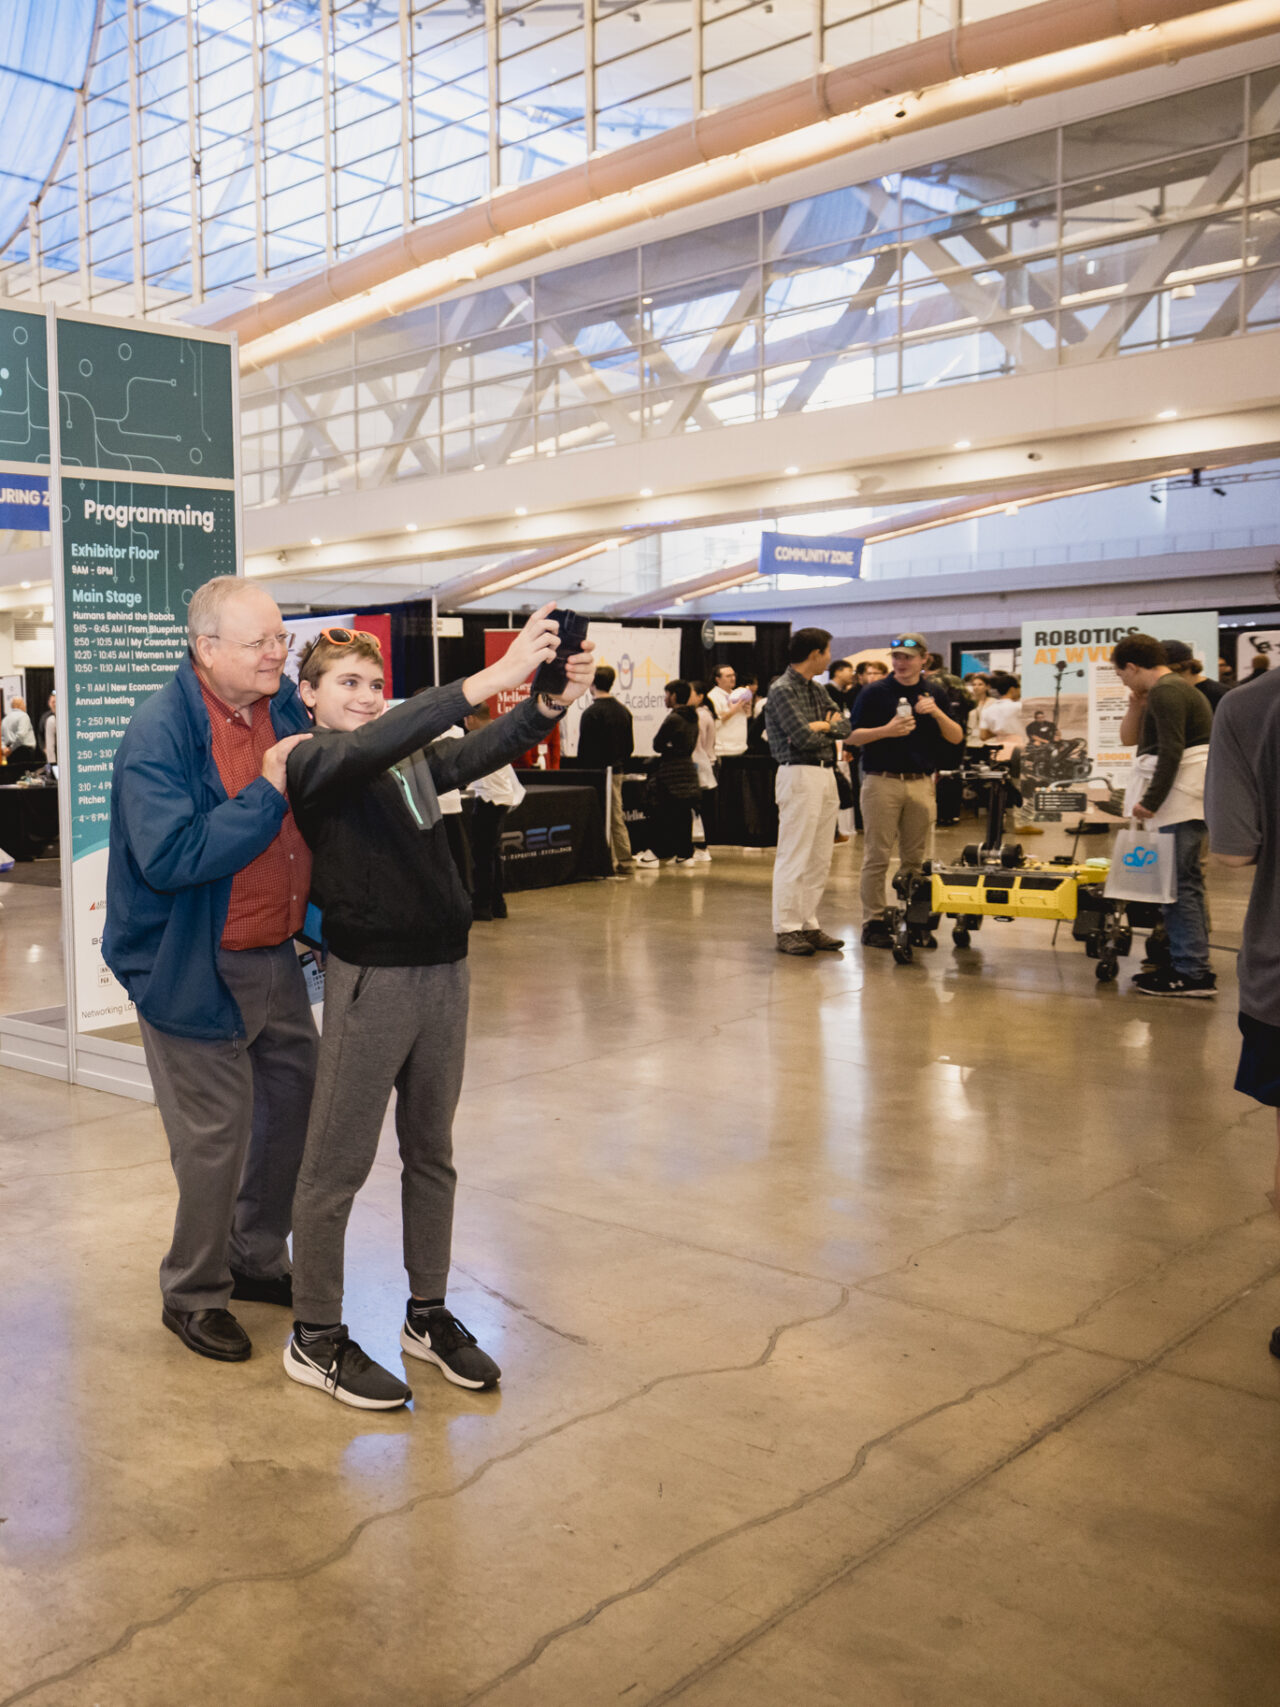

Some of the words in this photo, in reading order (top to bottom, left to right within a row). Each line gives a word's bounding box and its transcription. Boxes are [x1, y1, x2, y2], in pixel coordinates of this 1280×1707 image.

[84, 499, 214, 533] Programming
[71, 543, 126, 558] Exhibitor
[129, 546, 159, 560] Floor
[775, 546, 830, 563] COMMUNITY
[831, 550, 854, 565] ZONE
[73, 589, 103, 603] Main
[106, 590, 142, 608] Stage
[73, 611, 105, 620] Humans
[107, 612, 133, 620] Behind
[135, 612, 147, 620] the
[149, 612, 175, 621] Robots
[111, 625, 122, 633] AM
[128, 625, 147, 633] From
[149, 625, 183, 635] Blueprint
[1035, 627, 1139, 646] ROBOTICS
[114, 638, 125, 646] AM
[131, 638, 142, 648] My
[144, 638, 179, 646] Coworker
[119, 651, 129, 659] AM
[135, 651, 164, 659] Women
[1034, 648, 1060, 664] AT
[115, 664, 126, 672] AM
[132, 664, 149, 672] Tech
[75, 684, 80, 692] 9
[94, 684, 105, 692] AM
[76, 697, 102, 706] Annual
[104, 696, 135, 706] Meeting
[76, 718, 80, 726] 2
[105, 717, 115, 725] PM
[77, 731, 109, 741] Program
[78, 763, 107, 772] Summit
[98, 782, 103, 790] 4
[79, 796, 105, 804] Pitches
[82, 1005, 123, 1019] Networking
